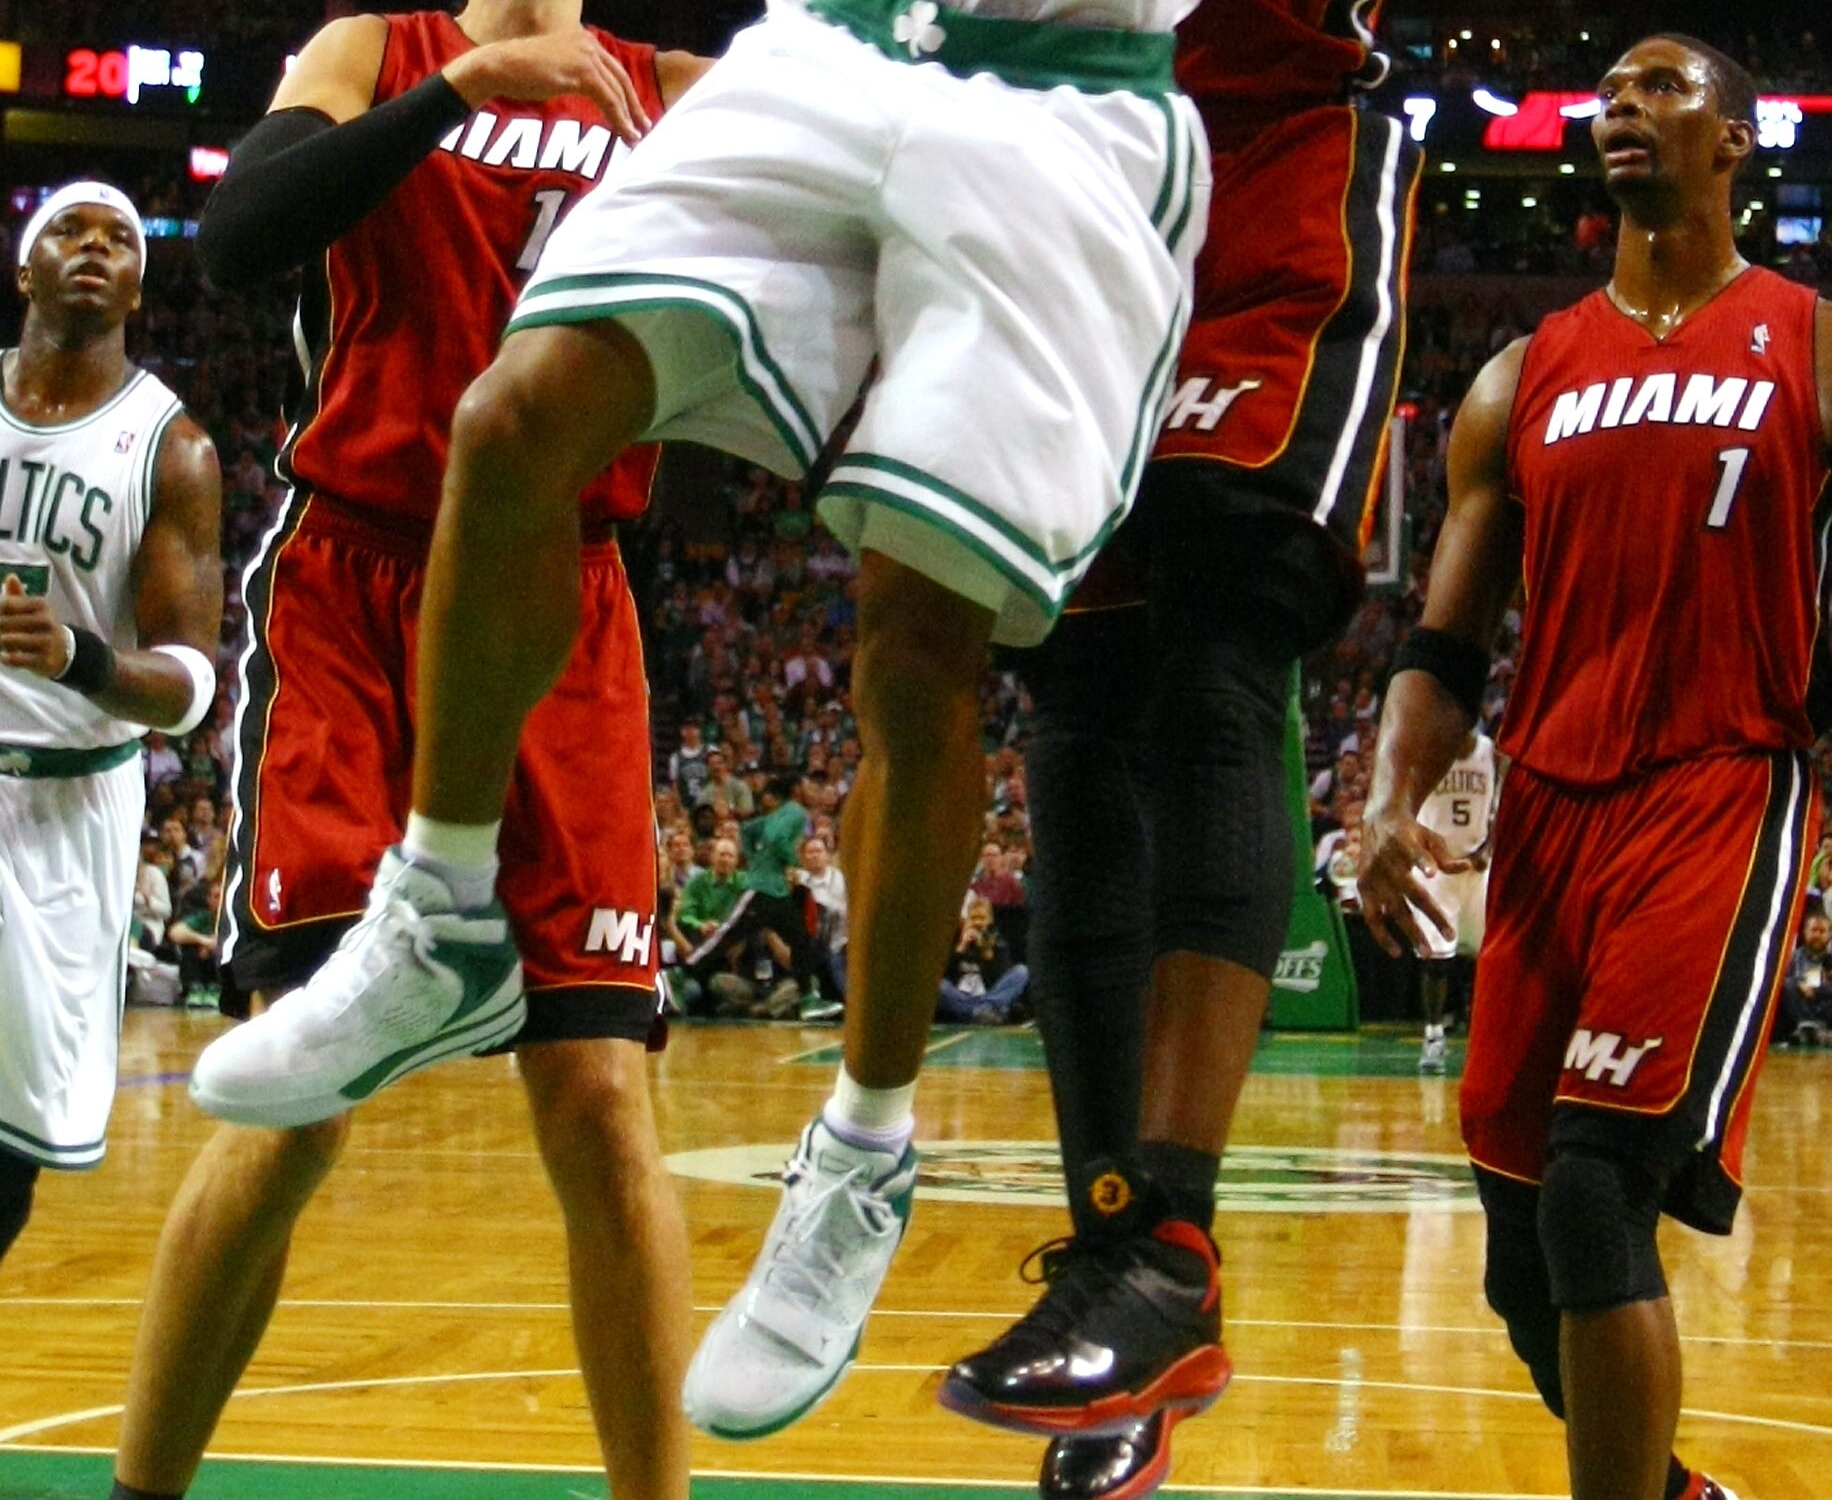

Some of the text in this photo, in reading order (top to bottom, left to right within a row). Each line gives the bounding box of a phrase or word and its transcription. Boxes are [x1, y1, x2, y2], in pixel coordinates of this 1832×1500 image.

[439, 111, 622, 180] IAM
[1544, 373, 1775, 445] MIAMI
[1707, 447, 1749, 528] 1
[1452, 800, 1471, 827] 5
